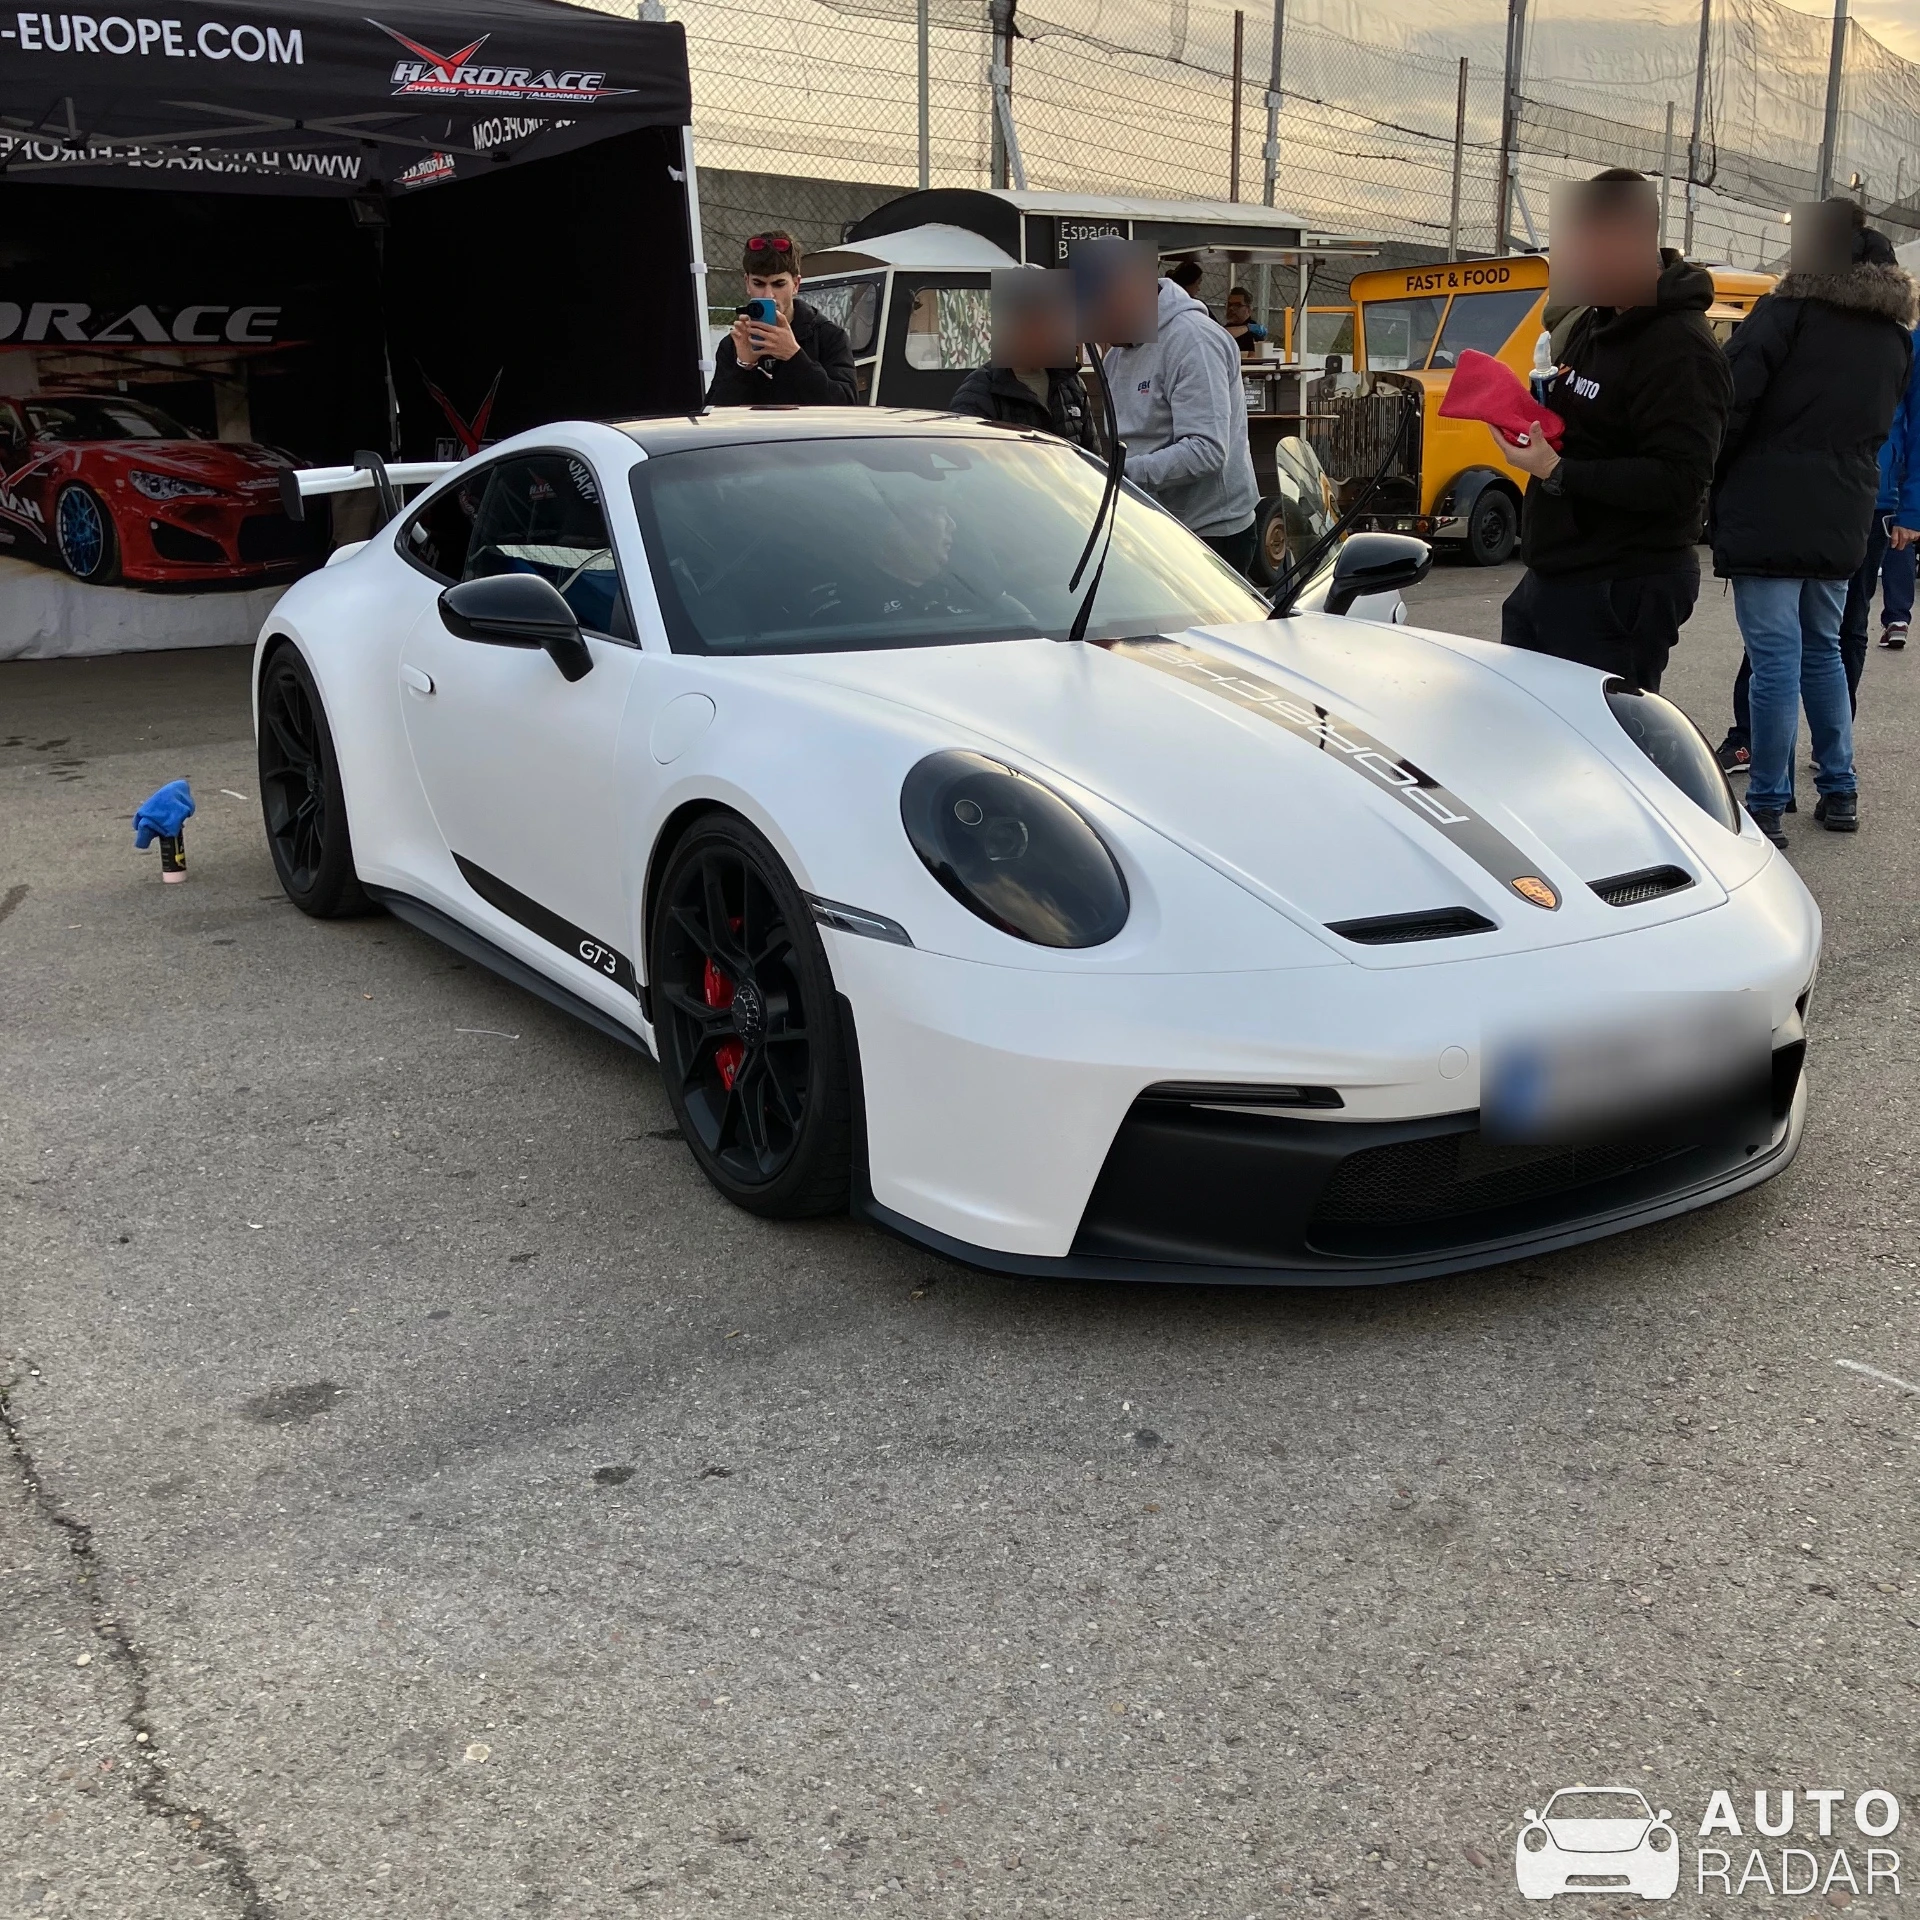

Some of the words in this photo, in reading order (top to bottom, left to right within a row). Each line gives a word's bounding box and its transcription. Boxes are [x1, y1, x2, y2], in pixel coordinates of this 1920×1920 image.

[393, 63, 603, 91] HARDRACE
[406, 84, 457, 94] CHASSIS
[467, 87, 522, 97] STEERING
[532, 91, 596, 101] ALIGNMENT
[1406, 273, 1444, 292] FAST
[1447, 272, 1459, 287] &
[1463, 267, 1510, 286] FOOD
[1141, 647, 1471, 825] PORSCHE
[579, 940, 616, 974] GT3
